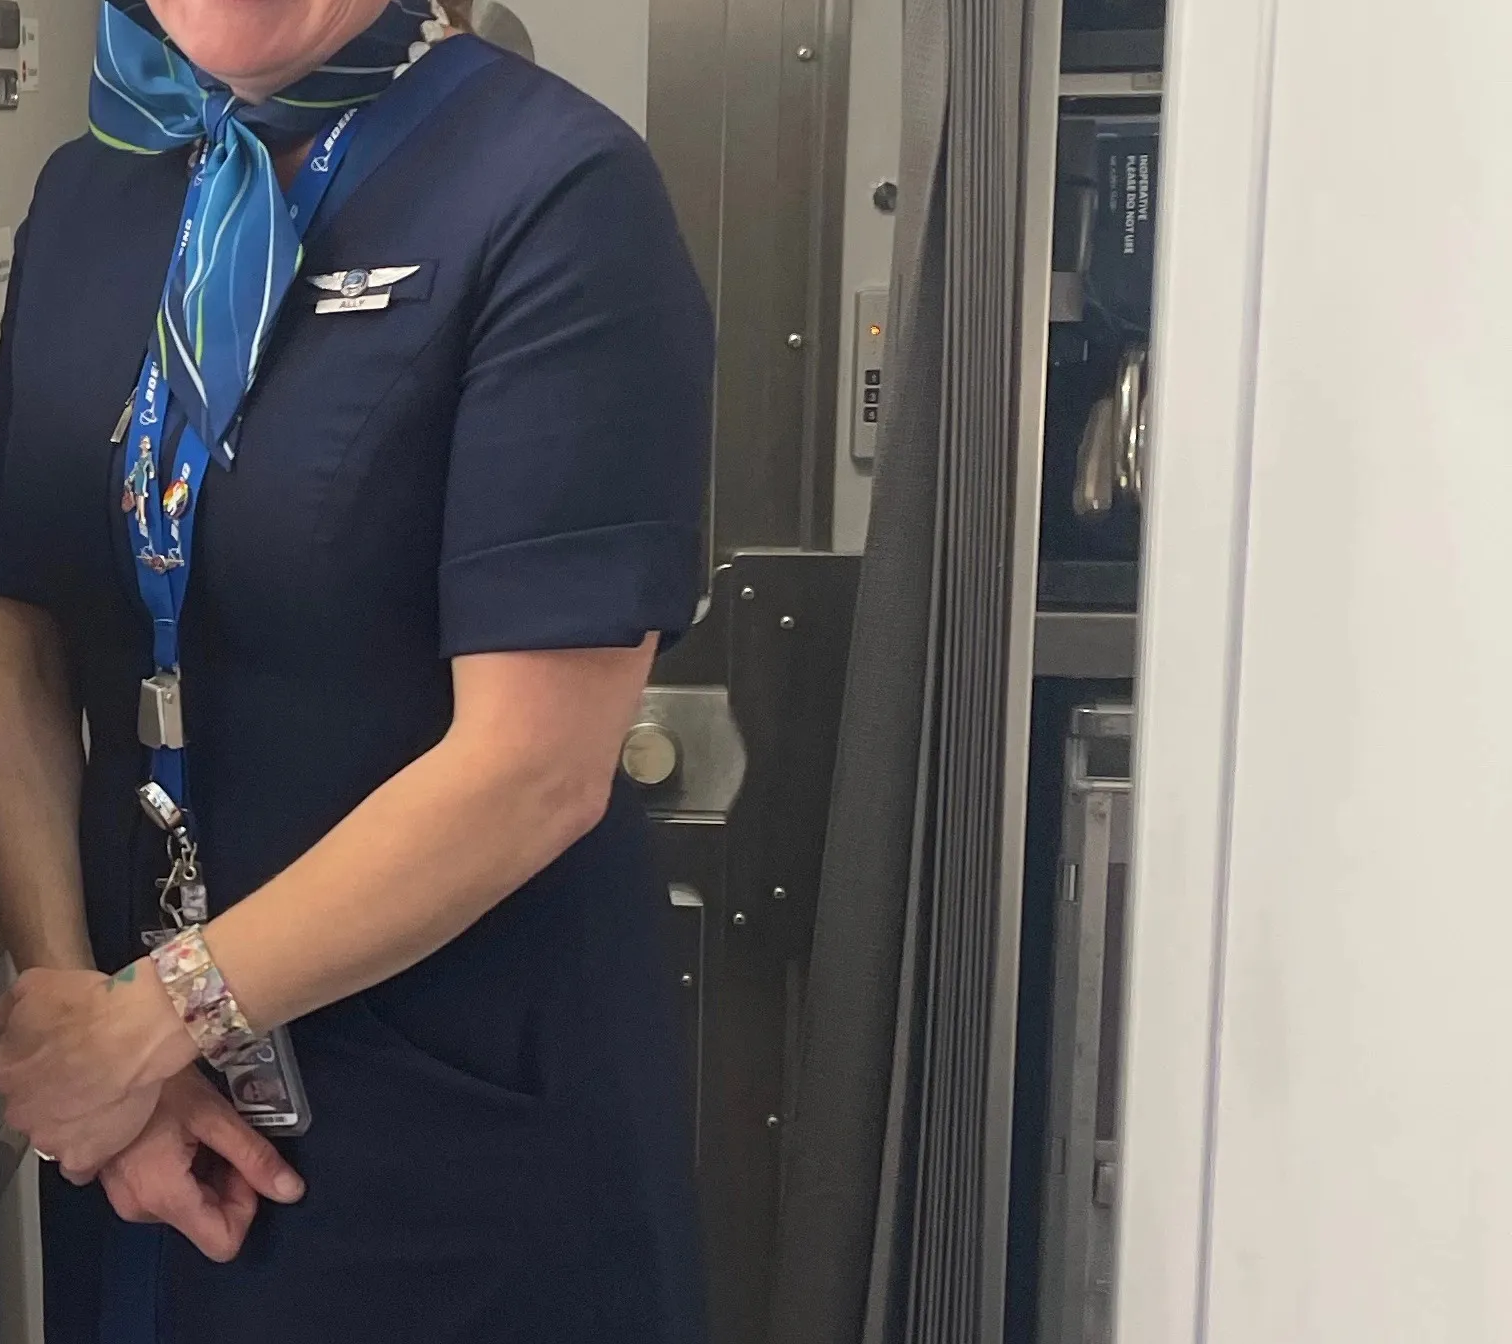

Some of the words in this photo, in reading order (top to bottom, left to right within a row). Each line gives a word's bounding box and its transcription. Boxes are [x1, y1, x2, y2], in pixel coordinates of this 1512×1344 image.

[1126, 156, 1137, 192] PLEASE
[1138, 155, 1148, 221] INOPERATIVE
[1126, 193, 1136, 208] DO
[1125, 212, 1136, 233] NOT
